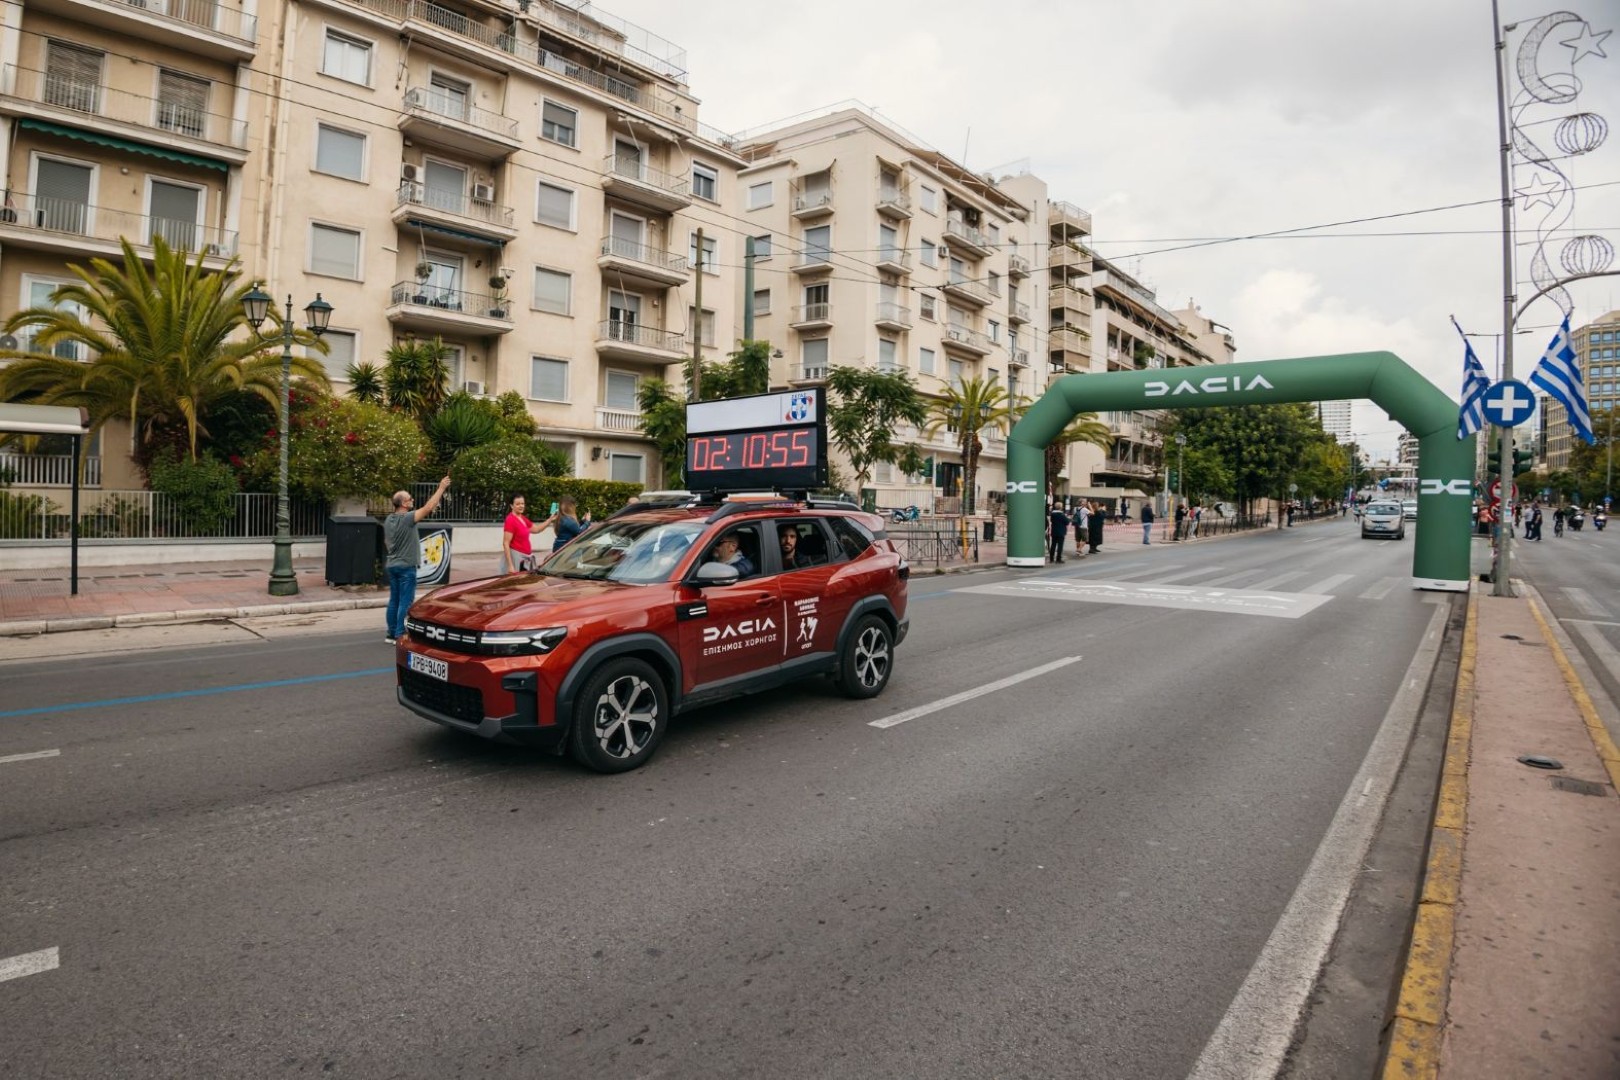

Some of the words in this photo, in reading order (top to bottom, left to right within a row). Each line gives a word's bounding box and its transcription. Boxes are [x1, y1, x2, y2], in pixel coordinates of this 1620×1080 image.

[1144, 374, 1274, 397] DACIA
[693, 431, 808, 470] 02:10:55
[703, 617, 777, 642] DACIA
[703, 642, 743, 656] ΕΠΙΣΗΜΟΣ
[745, 633, 777, 648] ΧΟΡΗΓΟΣ
